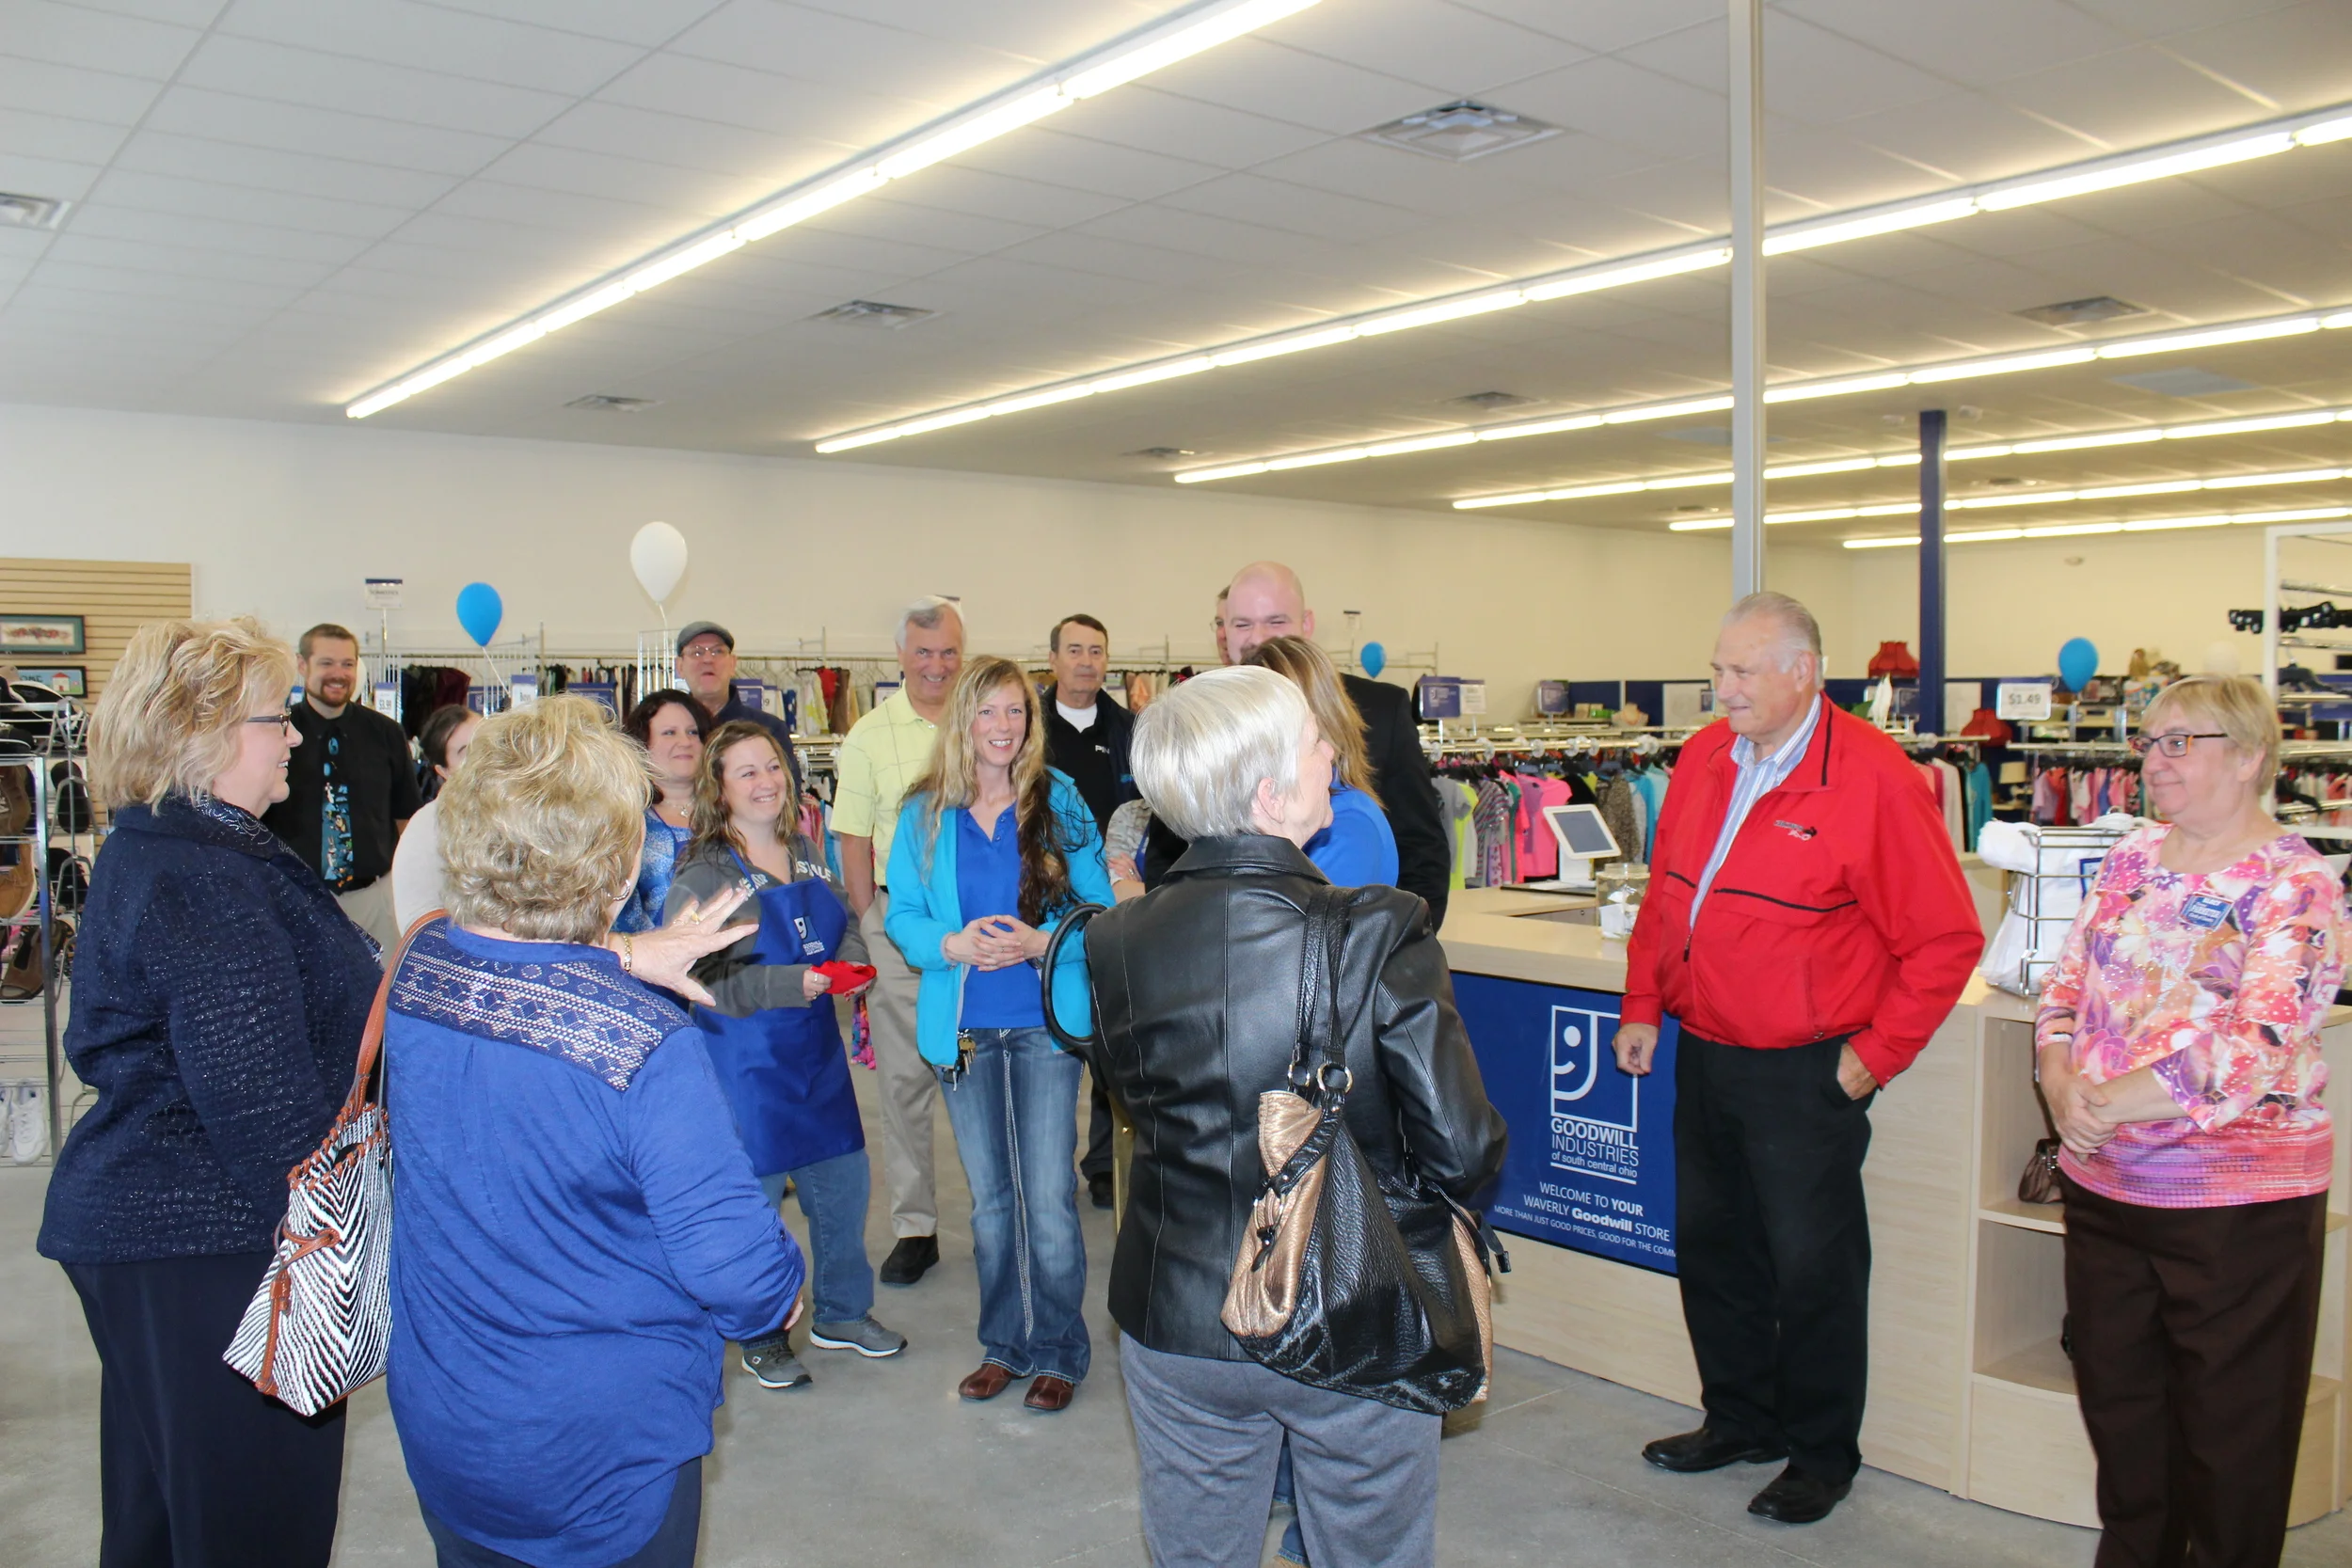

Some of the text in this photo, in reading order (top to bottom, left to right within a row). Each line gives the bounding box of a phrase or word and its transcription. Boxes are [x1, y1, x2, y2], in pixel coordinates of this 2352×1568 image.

[2009, 693, 2042, 705] $1.49
[1550, 1117, 1639, 1150] GOODWILL
[1551, 1151, 1637, 1179] of south central ohio
[1552, 1134, 1639, 1167] INDUSTRIES
[1539, 1181, 1645, 1217] WELCOME TO YOUR
[1494, 1205, 1514, 1217] MORE
[1514, 1210, 1534, 1222] THAN
[1534, 1214, 1549, 1227] JUST
[1550, 1219, 1572, 1231] GOOD
[1572, 1225, 1597, 1239] PRICES,
[1598, 1231, 1621, 1243] GOOD
[1621, 1237, 1637, 1248] FOR
[1638, 1241, 1652, 1252] THE
[1523, 1194, 1671, 1242] WAVERLY Goodwill STORE
